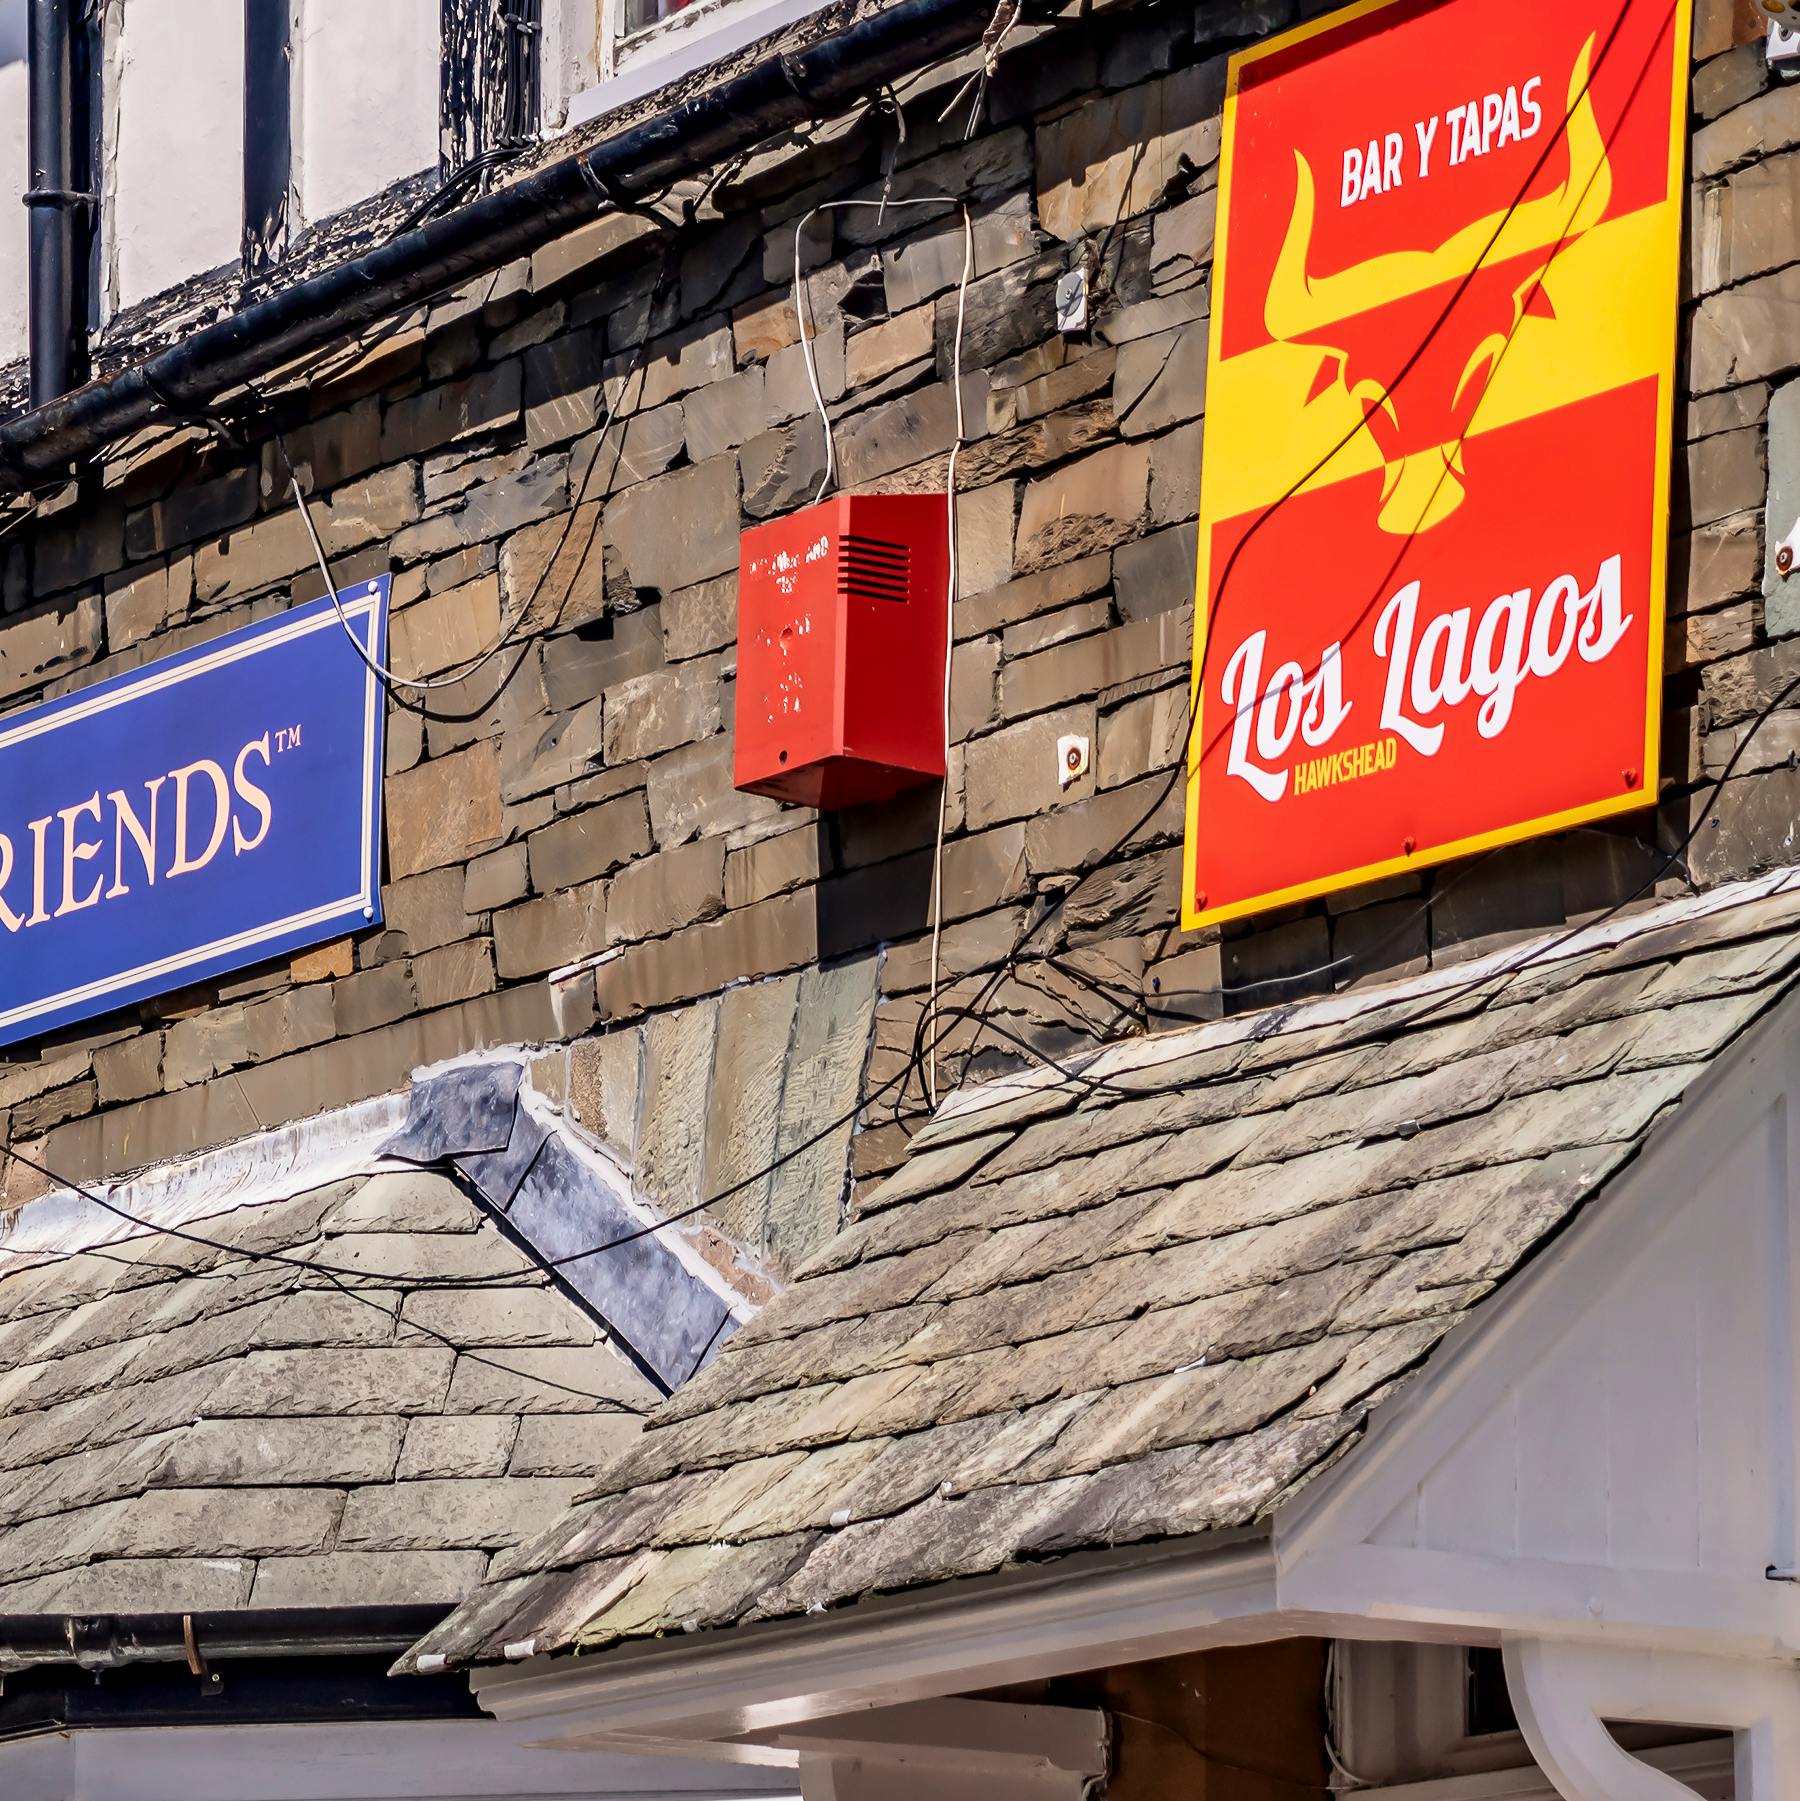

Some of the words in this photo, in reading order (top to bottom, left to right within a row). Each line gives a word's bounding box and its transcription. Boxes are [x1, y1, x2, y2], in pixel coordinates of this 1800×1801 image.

[1340, 132, 1403, 207] BAR
[1415, 116, 1439, 178] Y
[1446, 75, 1542, 166] TAPAS
[1220, 629, 1353, 802] Los
[1372, 553, 1634, 757] Lagos
[1293, 736, 1398, 796] HAWKSHEAD
